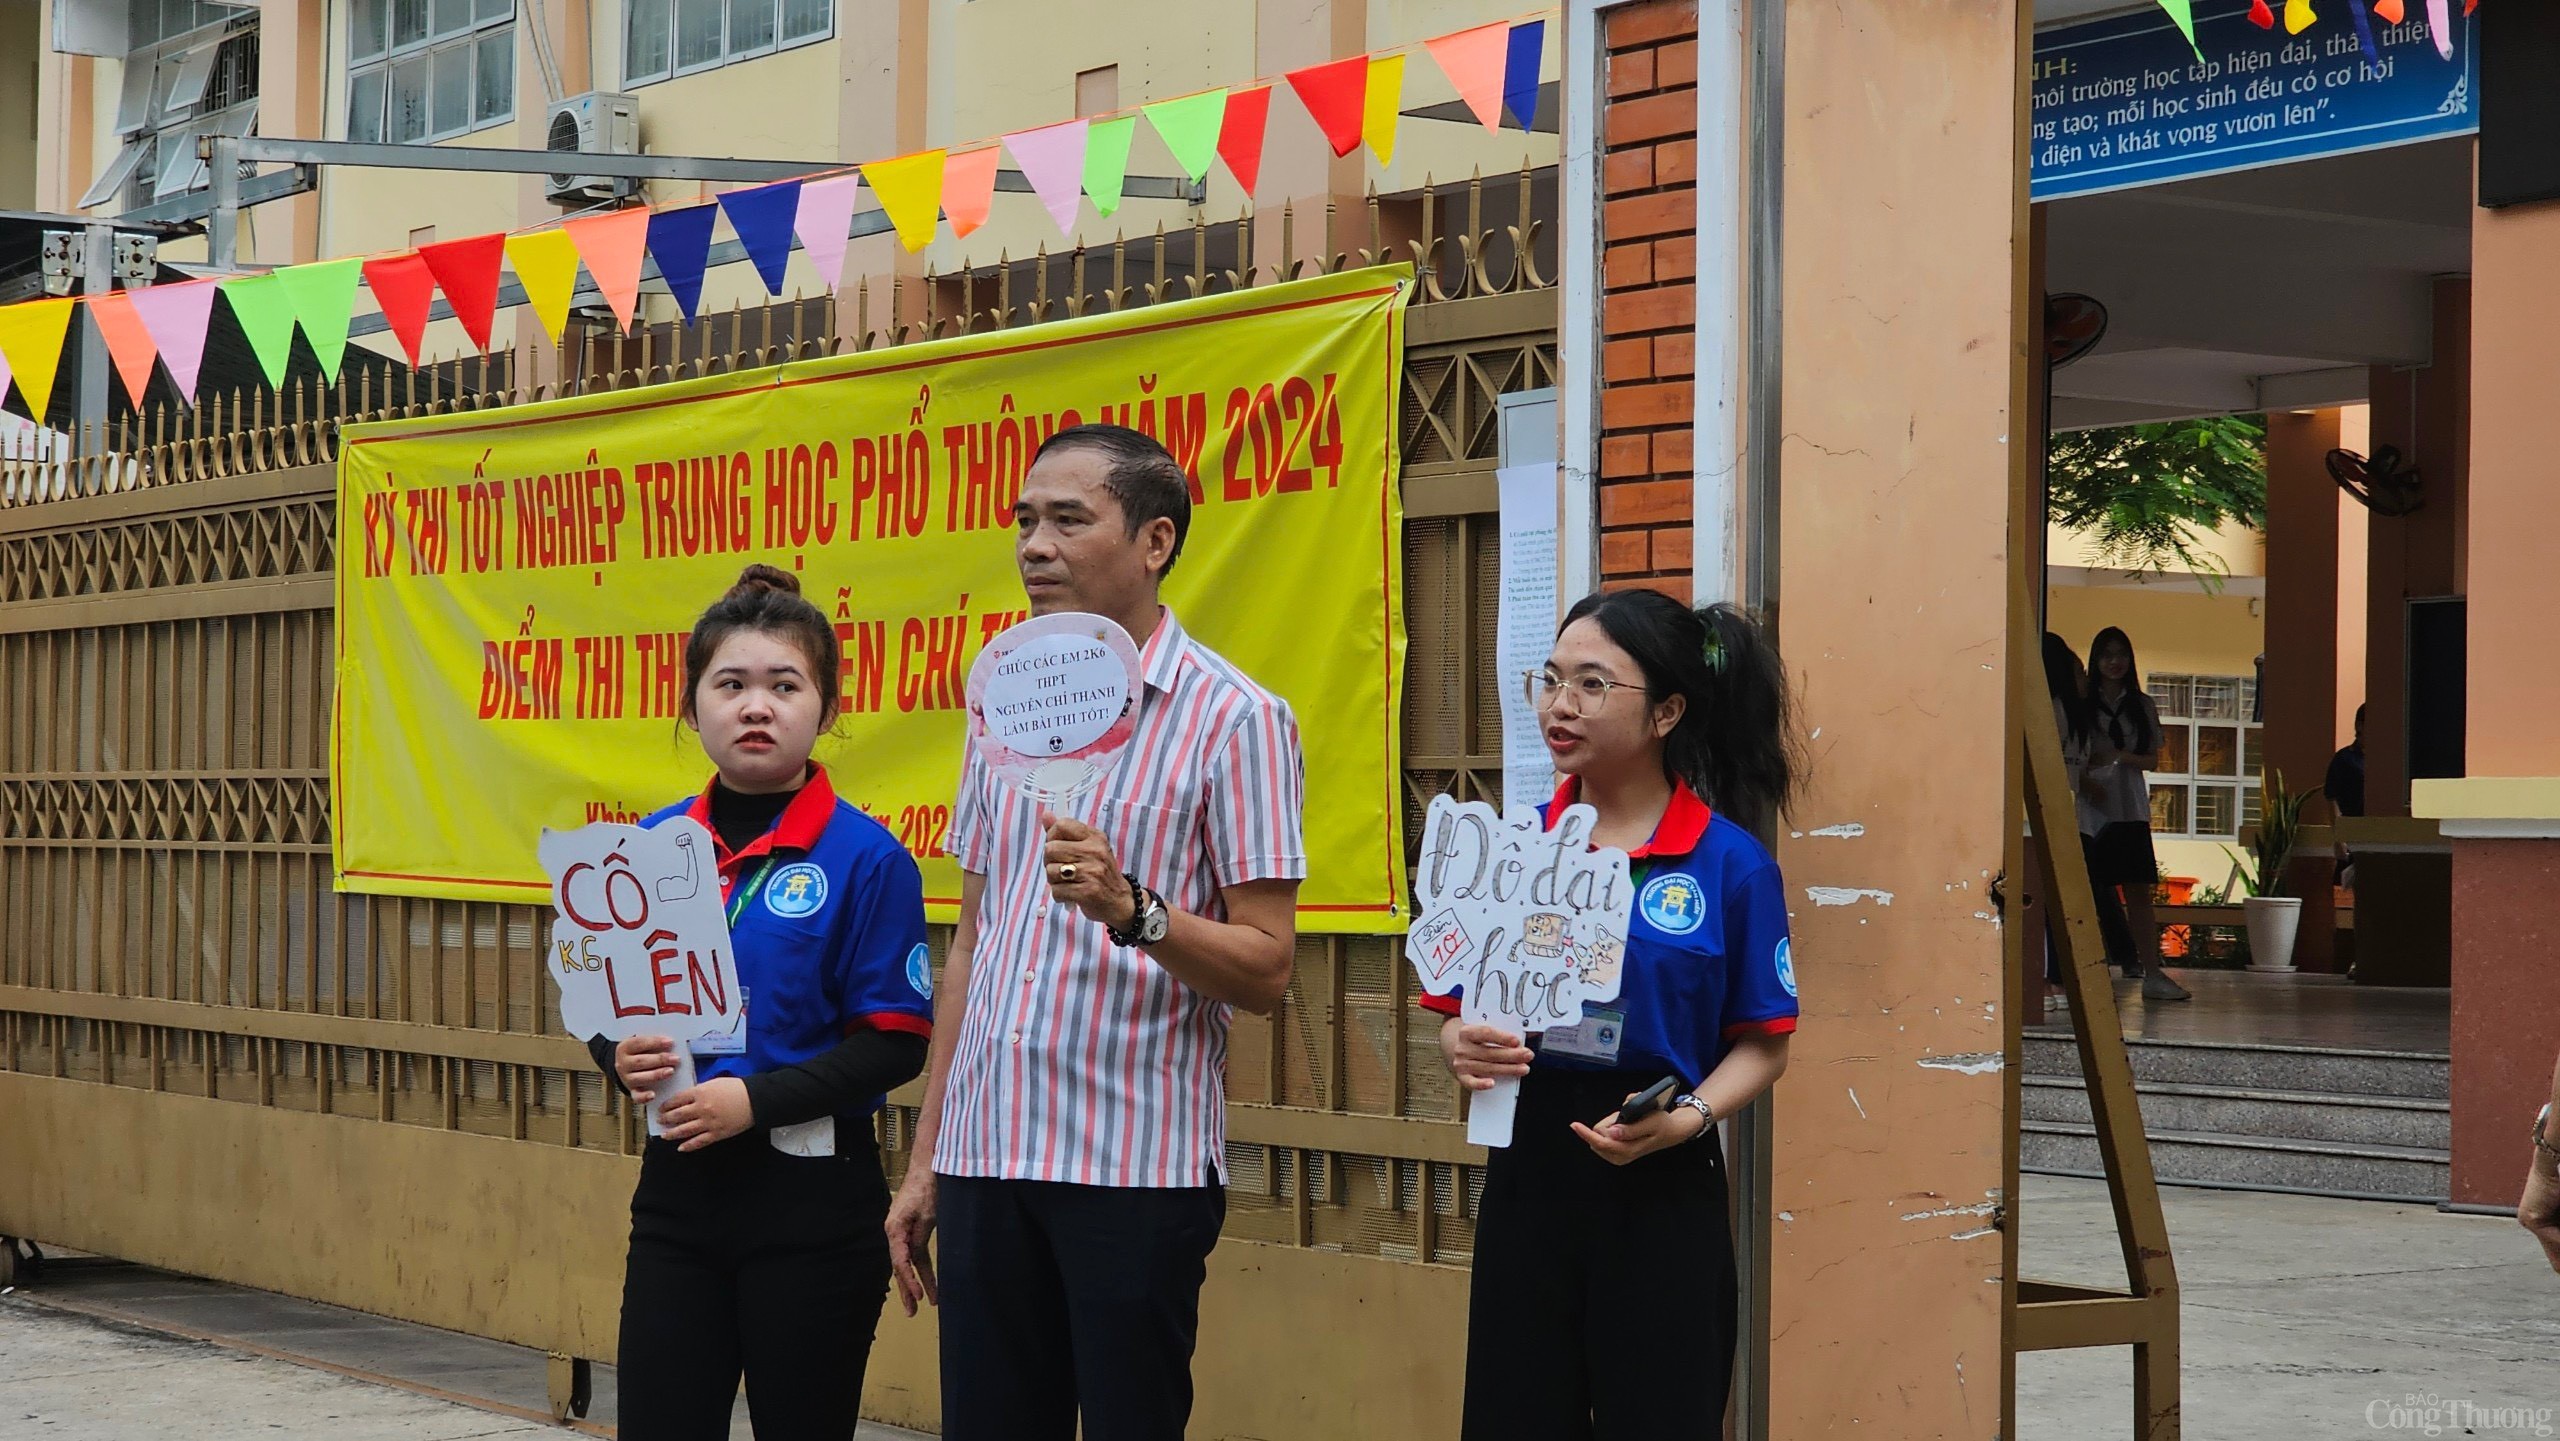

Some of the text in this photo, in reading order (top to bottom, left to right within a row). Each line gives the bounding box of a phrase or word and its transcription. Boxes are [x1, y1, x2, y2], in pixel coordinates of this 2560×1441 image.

[2033, 55, 2394, 140] ng tạo; mỗi học sinh đều có cơ hội
[2072, 77, 2137, 103] trường
[2144, 68, 2180, 90] học
[2188, 61, 2220, 83] tập
[2228, 50, 2272, 74] hiện
[2280, 39, 2317, 65] đại,
[2326, 33, 2363, 56] thâ
[2041, 144, 2082, 167] diện
[2089, 136, 2114, 158] và
[2118, 129, 2161, 154] khát
[2168, 121, 2219, 146] vọng
[2224, 112, 2276, 136] vươn
[365, 472, 398, 578] KỲ
[406, 487, 448, 576] THI
[457, 448, 505, 573] TỐT
[514, 448, 625, 586] NGHIỆP
[635, 451, 751, 560] TRUNG
[764, 441, 838, 571] HỌC
[850, 384, 930, 541] PHỔ
[1223, 373, 1344, 502] 2024
[478, 604, 562, 720] ĐIỂM
[574, 635, 624, 719] THI
[897, 593, 968, 713] CHÍ
[998, 647, 1106, 676] CHÚC CÁC EM 2K6
[1036, 673, 1067, 689] THPT
[1003, 705, 1109, 736] LÀM BÀI THI TỐT!
[1045, 691, 1068, 711] CHÍ
[1070, 686, 1115, 704] THANH
[900, 804, 955, 858] 202
[1426, 810, 1620, 915] Đỗ đại
[562, 838, 649, 931] CỐ
[558, 935, 602, 973] K6
[605, 929, 727, 1018] LÊN
[1469, 926, 1572, 1027] học
